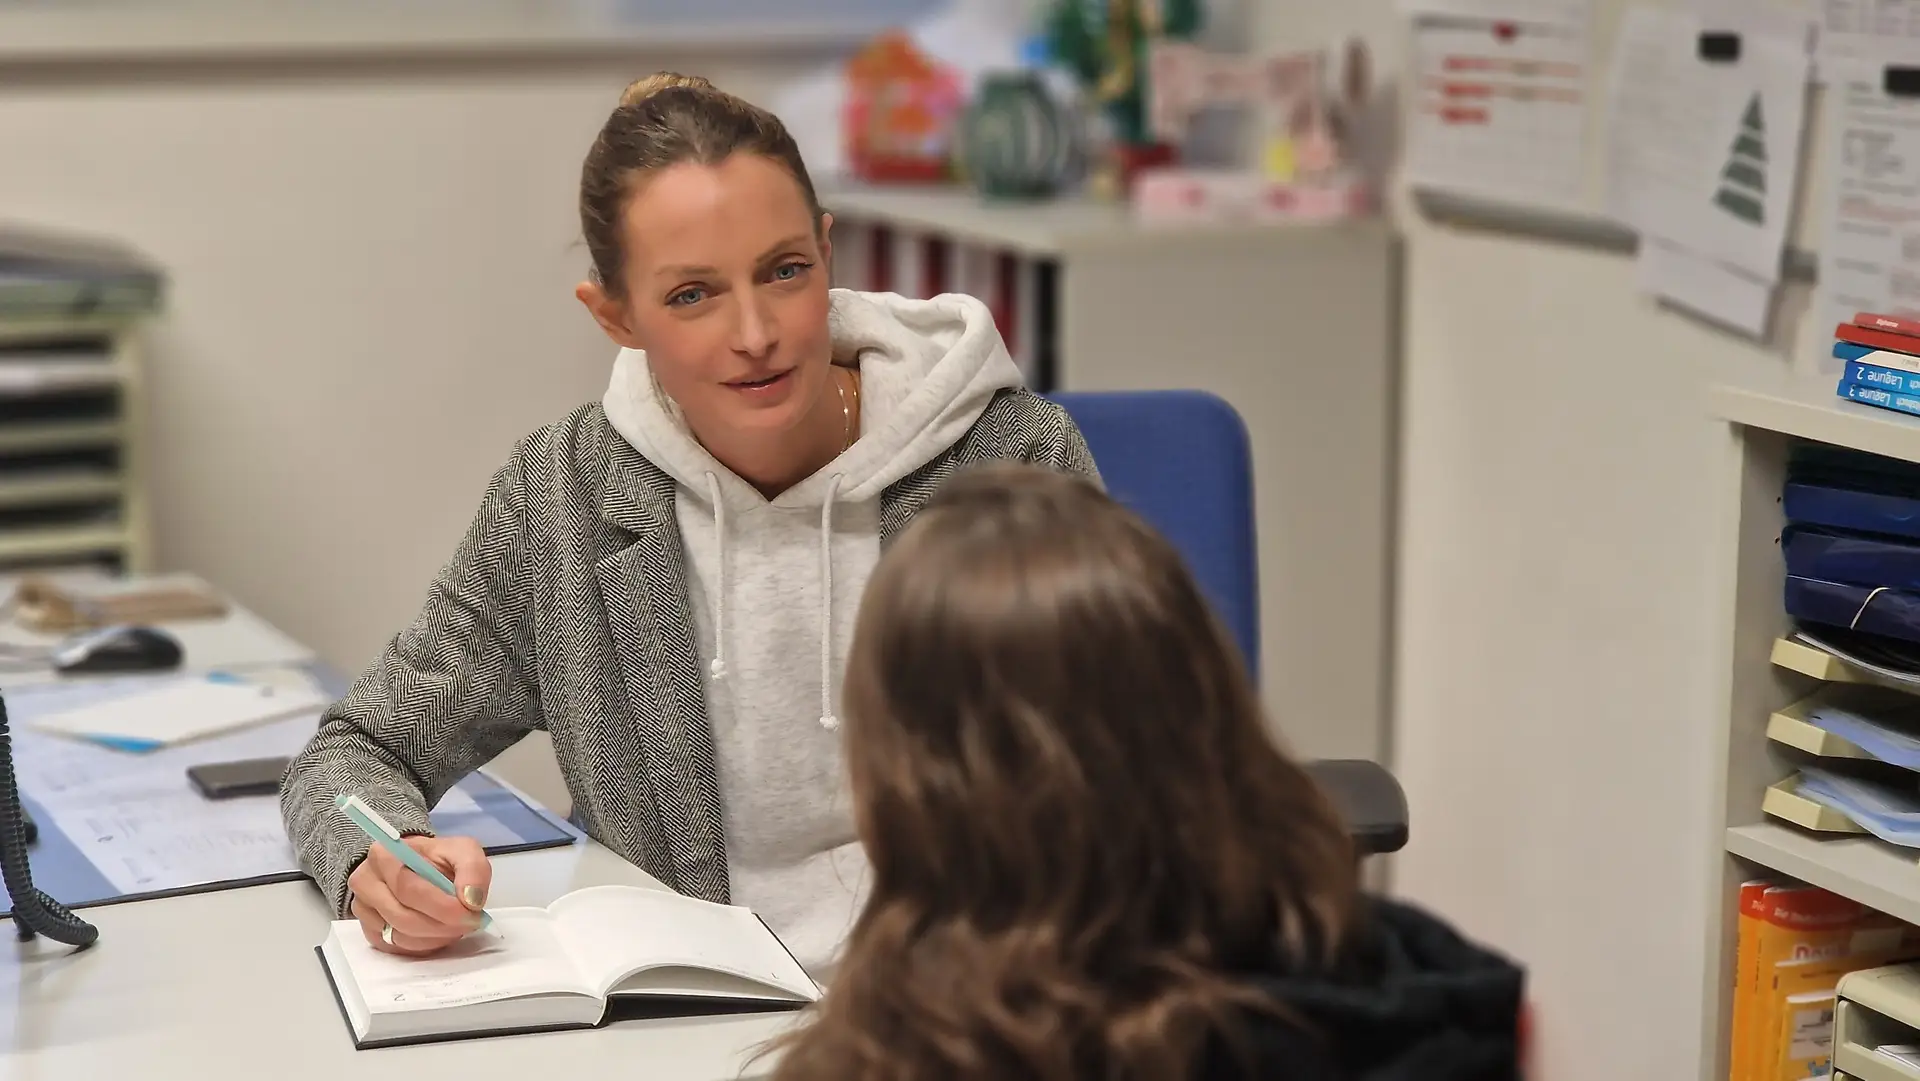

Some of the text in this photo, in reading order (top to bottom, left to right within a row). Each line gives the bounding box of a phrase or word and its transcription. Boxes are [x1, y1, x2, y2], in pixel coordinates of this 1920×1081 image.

[1856, 366, 1865, 380] 2
[1867, 370, 1903, 389] Lagune
[1849, 384, 1856, 397] 3
[1858, 388, 1890, 407] Lagune
